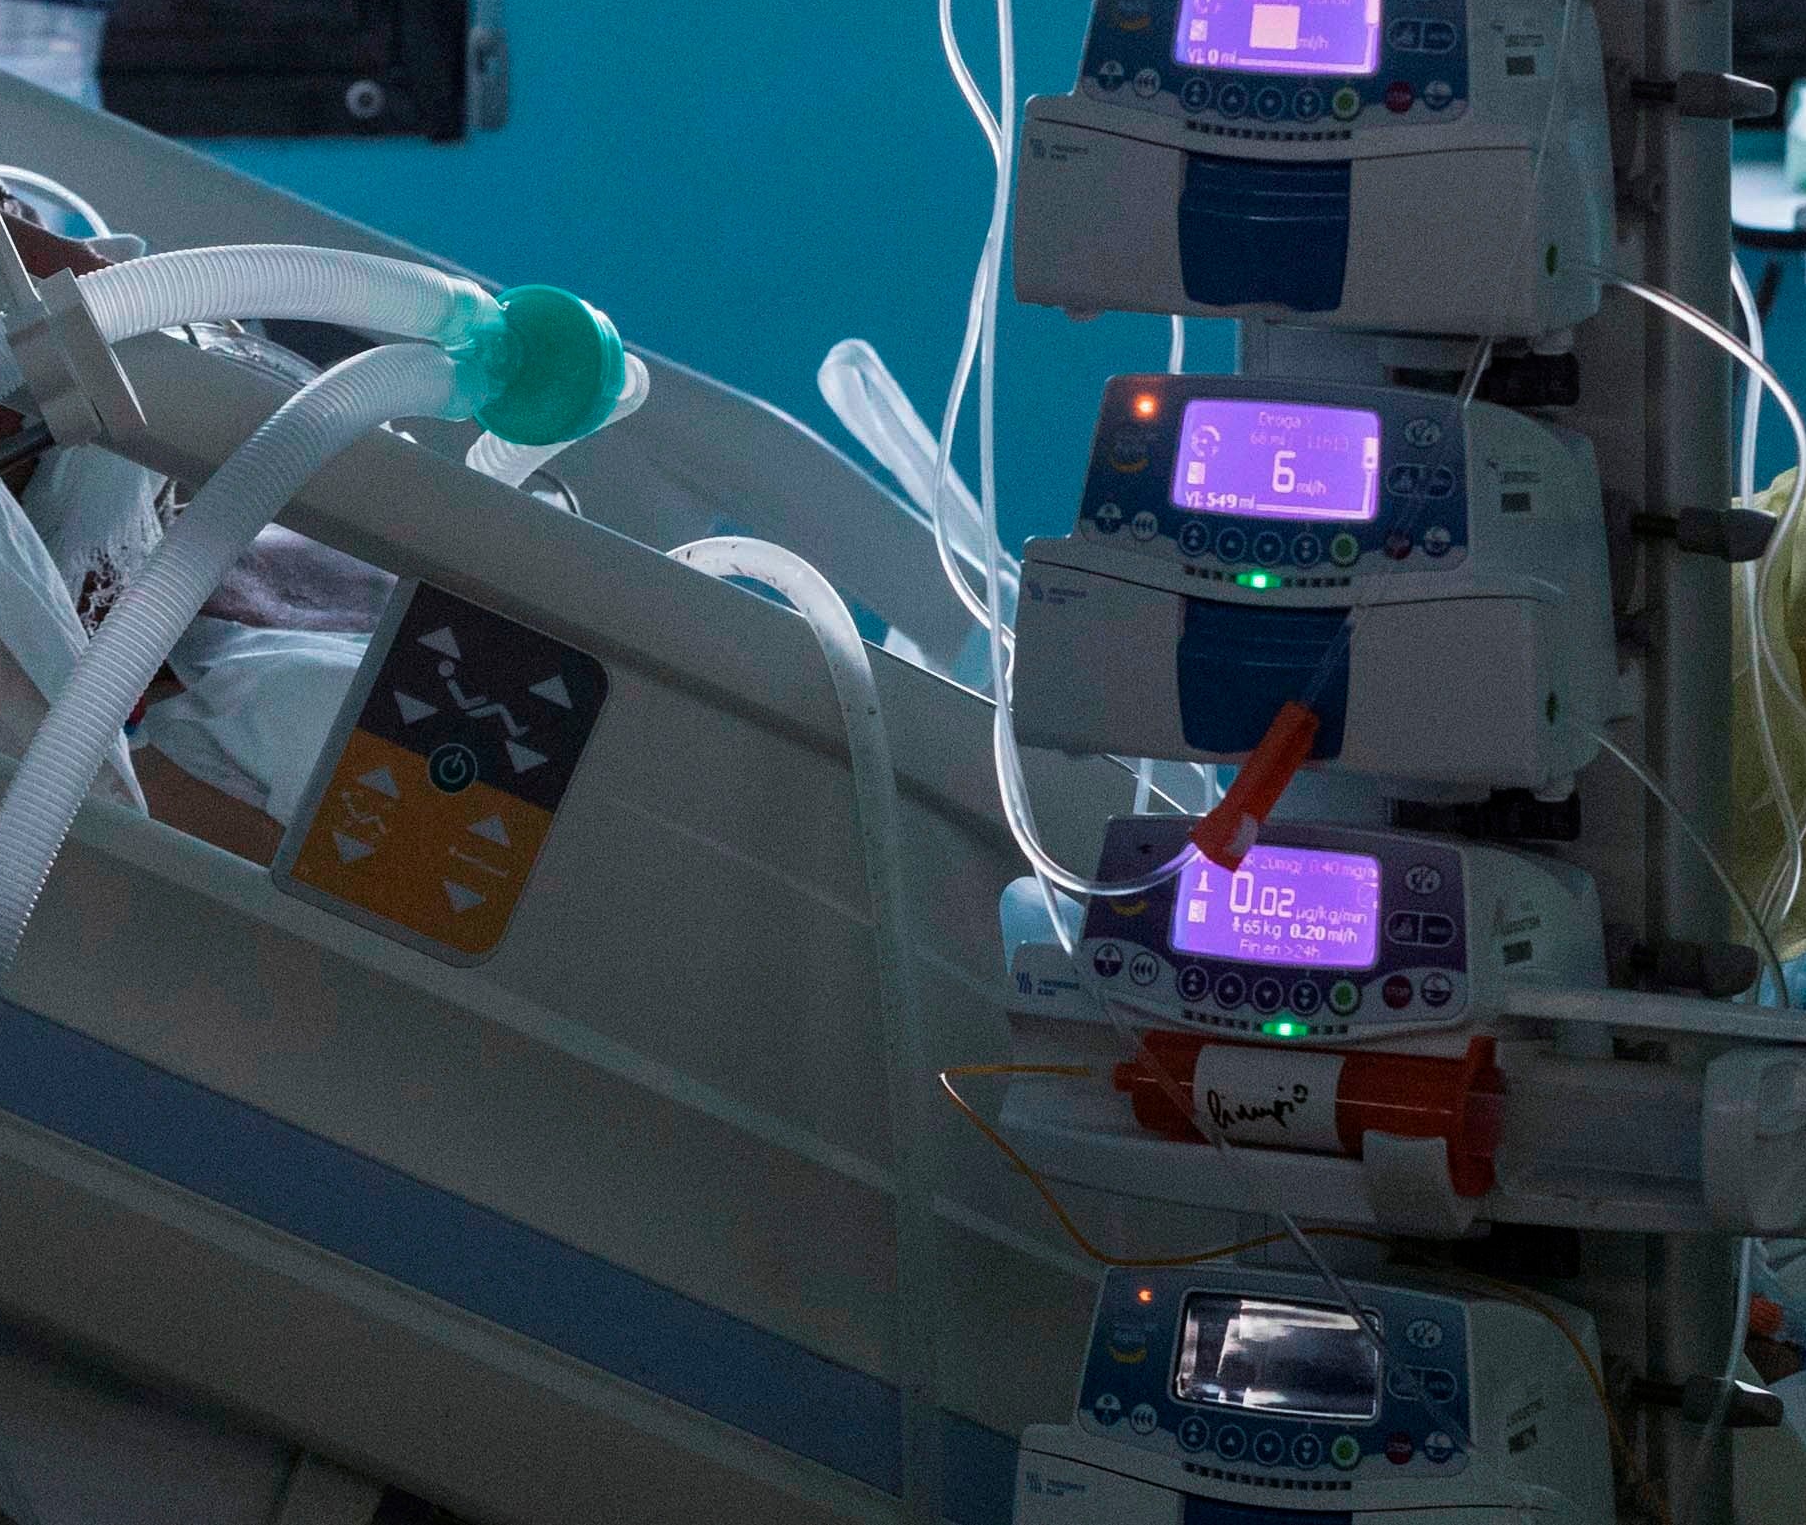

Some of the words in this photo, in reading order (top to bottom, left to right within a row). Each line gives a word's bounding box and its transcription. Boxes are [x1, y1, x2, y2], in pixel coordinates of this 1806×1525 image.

[1271, 449, 1298, 494] 6
[1206, 491, 1238, 508] 549
[1229, 871, 1296, 918] 0.02
[1243, 919, 1261, 935] 65
[1263, 920, 1282, 940] kg
[1289, 923, 1326, 941] 0.20
[1327, 927, 1358, 945] ml/h
